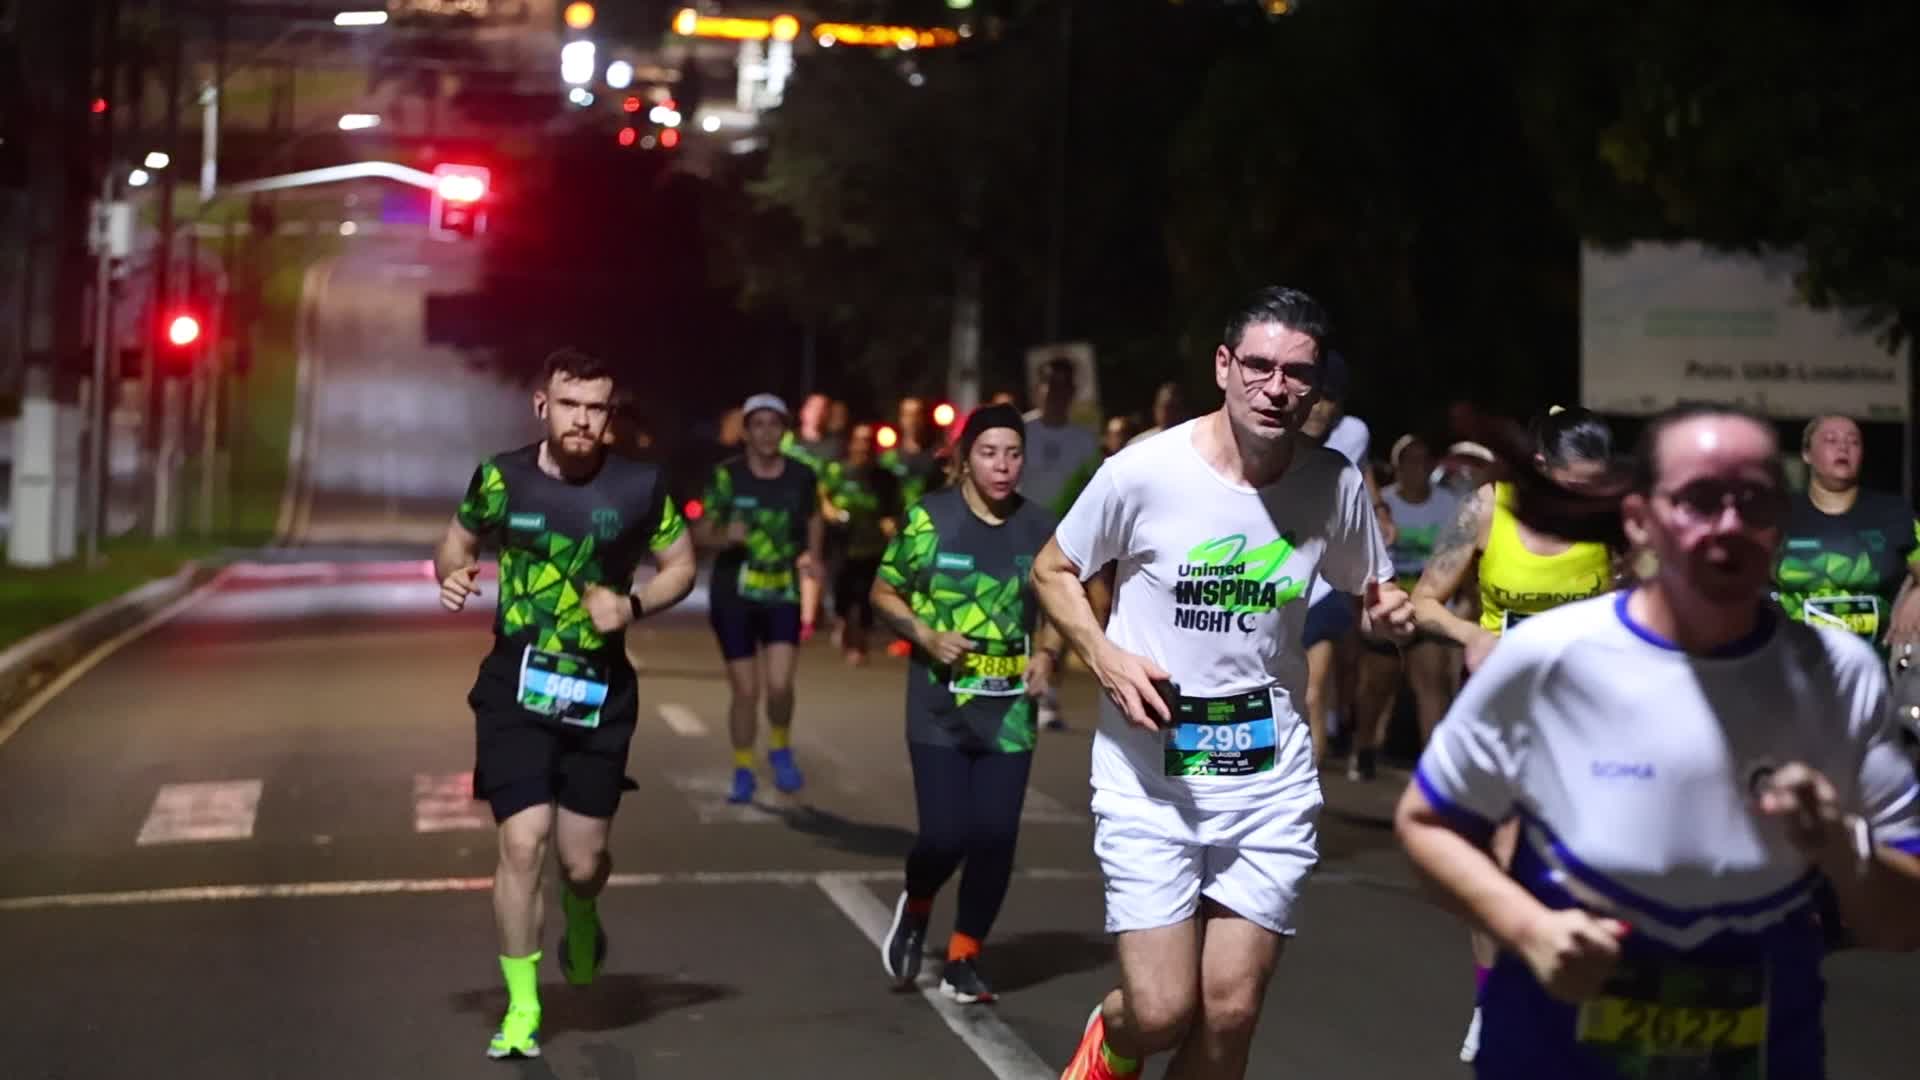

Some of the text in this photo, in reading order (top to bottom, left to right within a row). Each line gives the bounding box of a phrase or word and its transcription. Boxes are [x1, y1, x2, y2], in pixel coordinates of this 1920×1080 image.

[1178, 562, 1246, 576] Unimed
[1175, 579, 1276, 607] INSPIRA
[1174, 608, 1233, 632] NIGHT
[1196, 723, 1252, 751] 296
